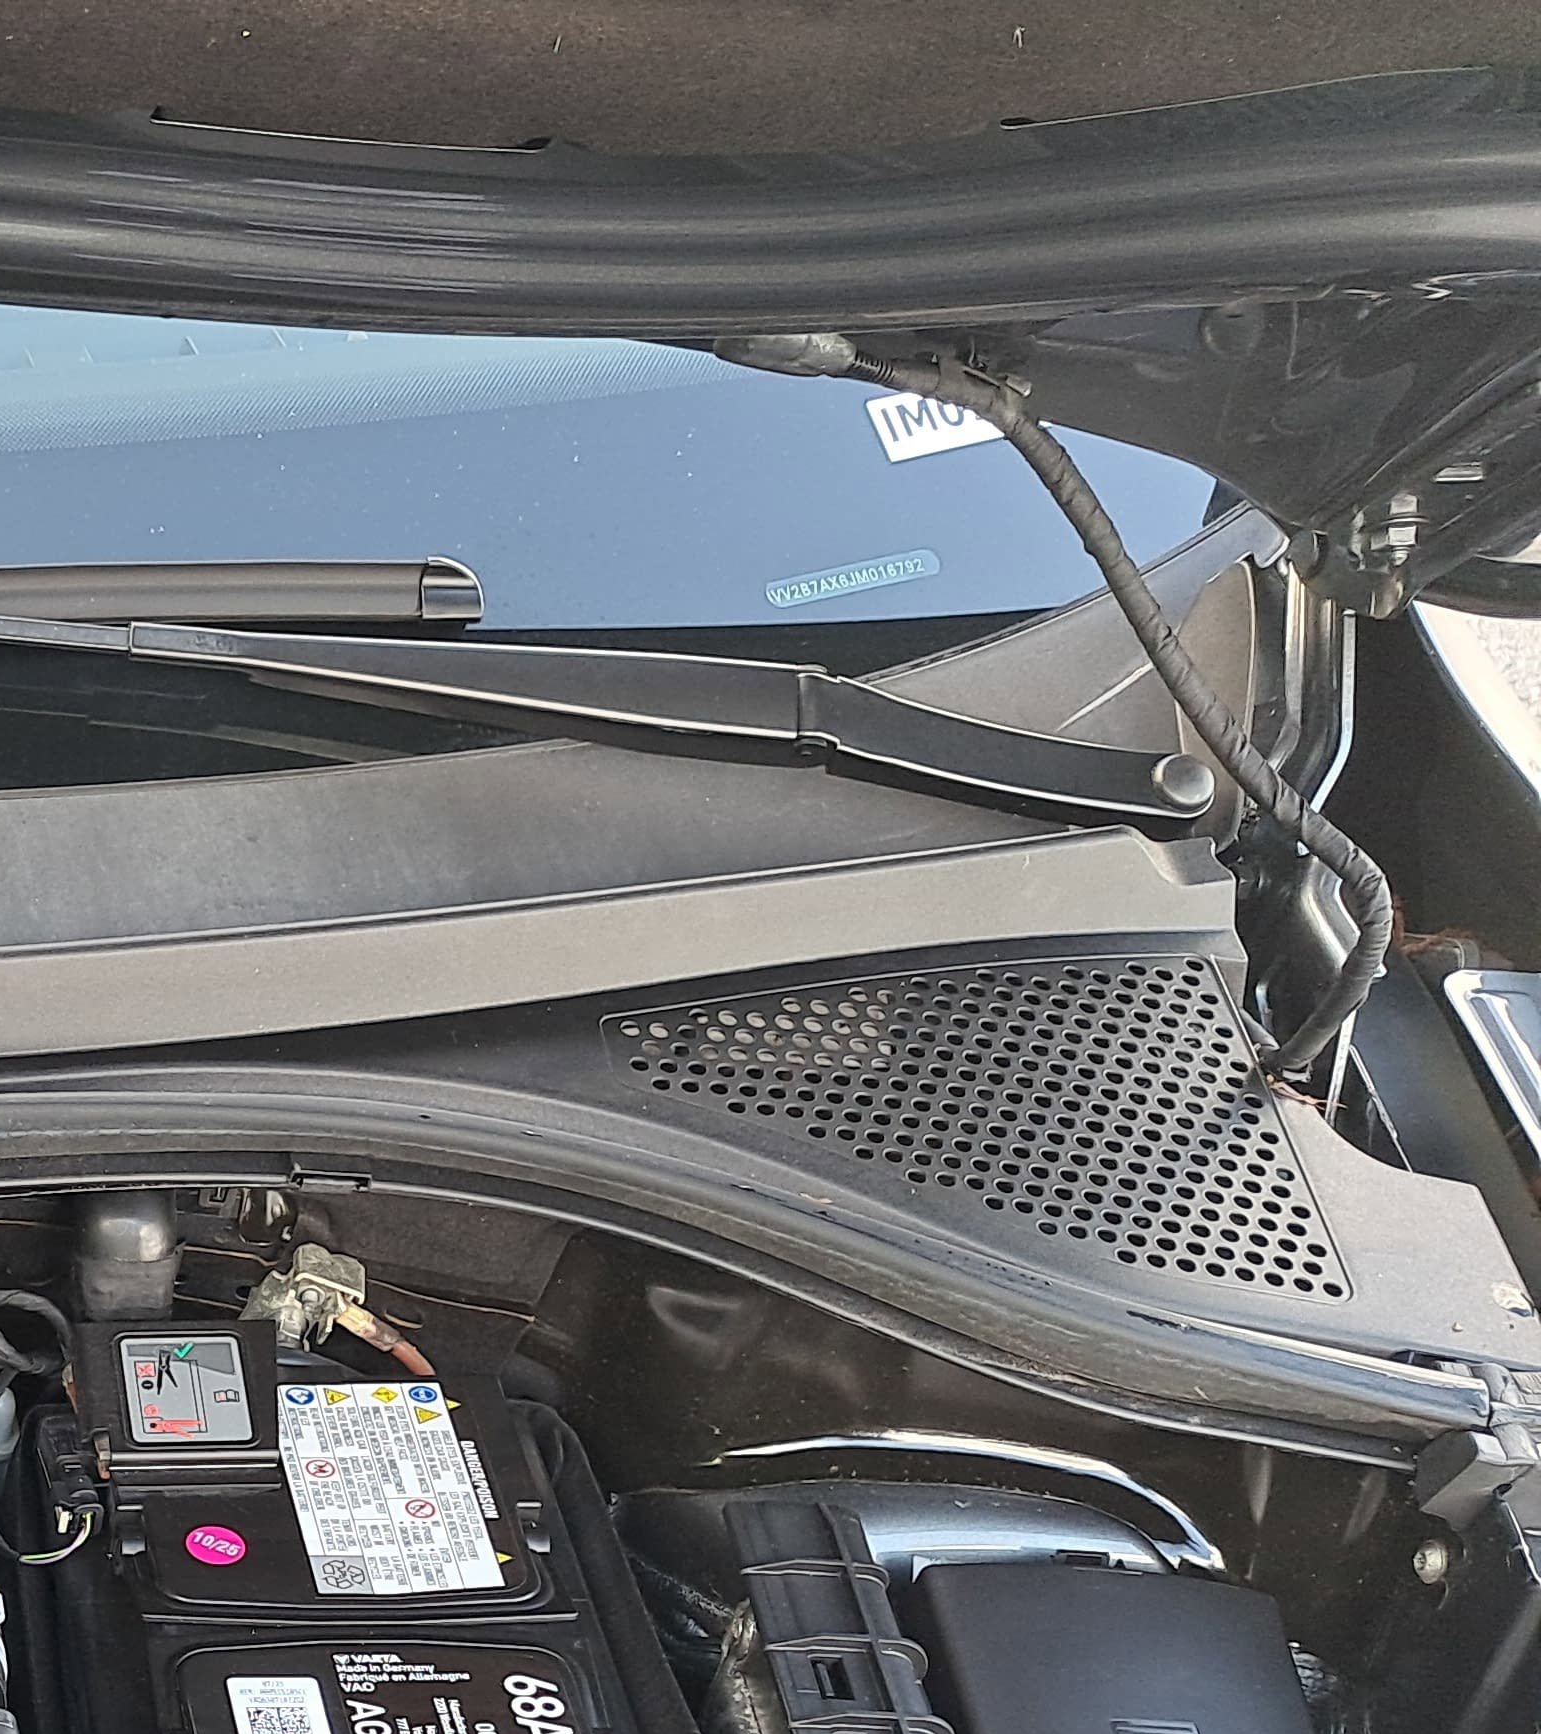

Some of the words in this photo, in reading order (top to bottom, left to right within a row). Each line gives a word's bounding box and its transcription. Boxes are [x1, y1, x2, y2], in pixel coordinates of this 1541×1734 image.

[881, 399, 983, 442] IM0
[460, 1440, 500, 1518] DANGER/POISON
[193, 1531, 241, 1557] 10/25
[351, 1654, 404, 1663] VARTA
[336, 1665, 367, 1673] Made
[369, 1664, 381, 1673] in
[382, 1665, 435, 1674] Germany
[392, 1674, 407, 1682] en
[409, 1673, 470, 1682] Allemagne
